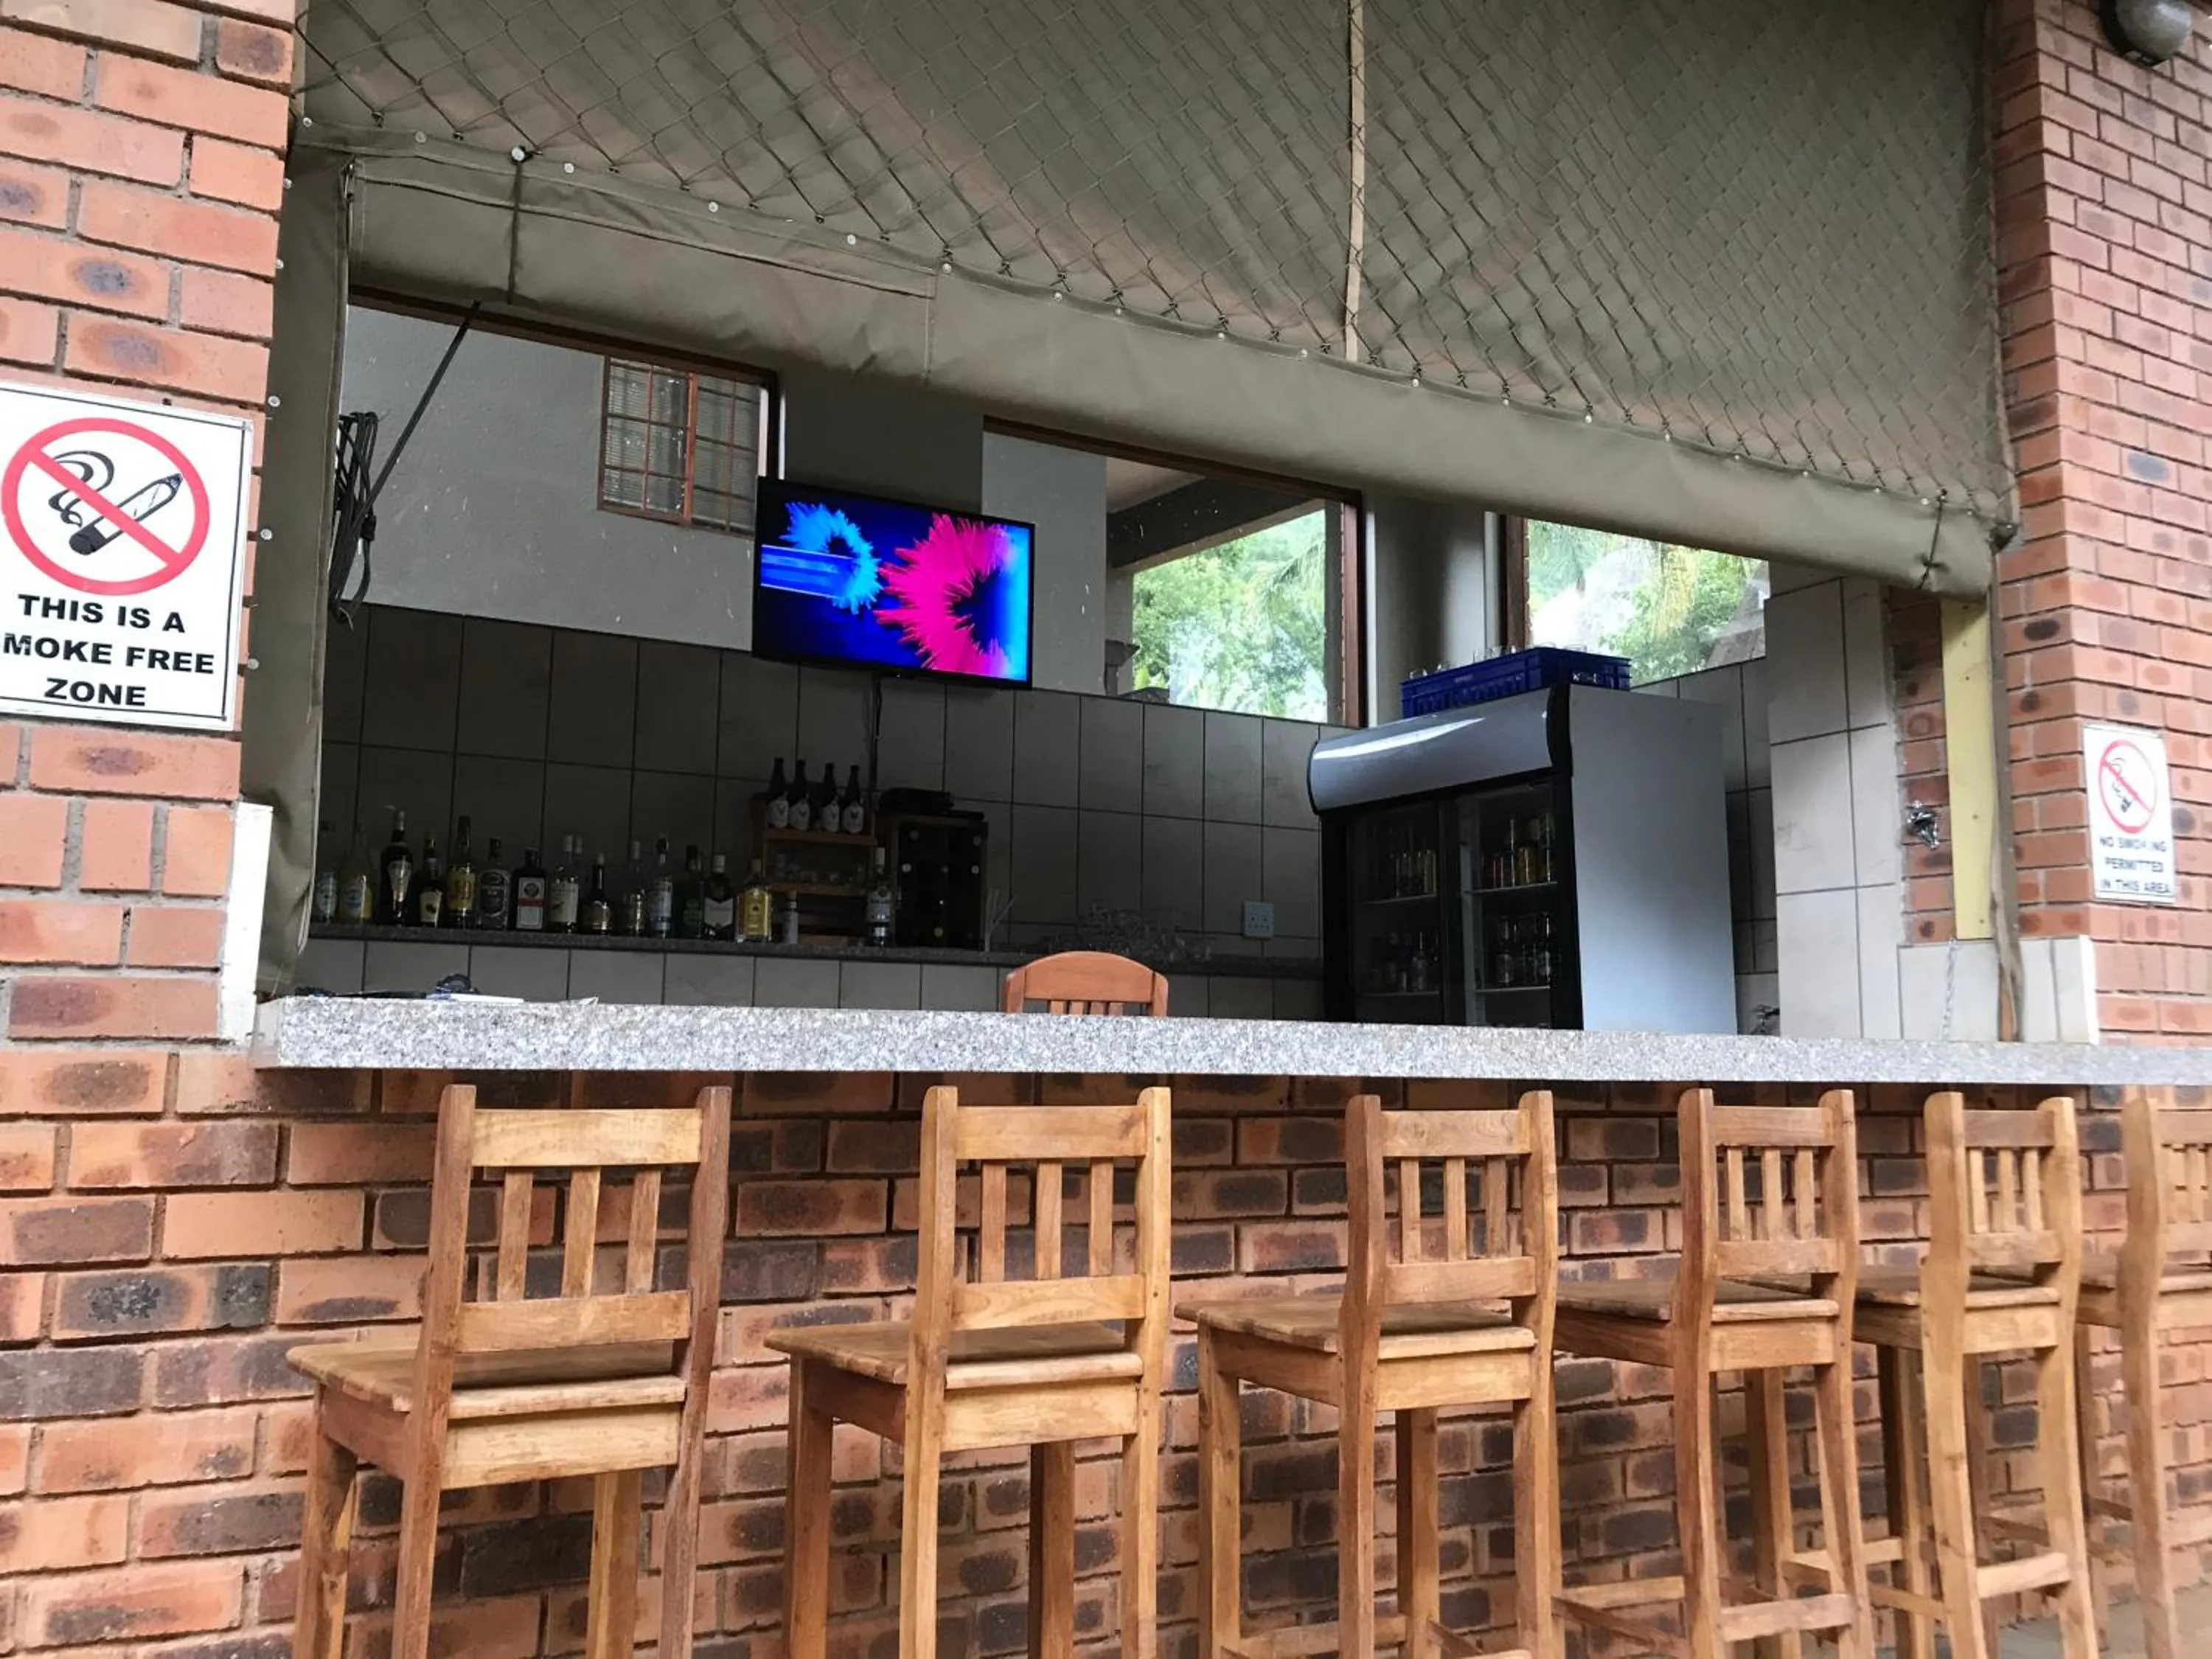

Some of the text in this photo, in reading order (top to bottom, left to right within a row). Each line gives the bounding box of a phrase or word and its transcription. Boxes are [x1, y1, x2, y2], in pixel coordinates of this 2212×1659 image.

[18, 594, 186, 633] THIS IS A
[2, 633, 215, 675] MOKE FREE
[44, 678, 147, 706] ZONE
[2099, 836, 2166, 852] NO SMOKNG
